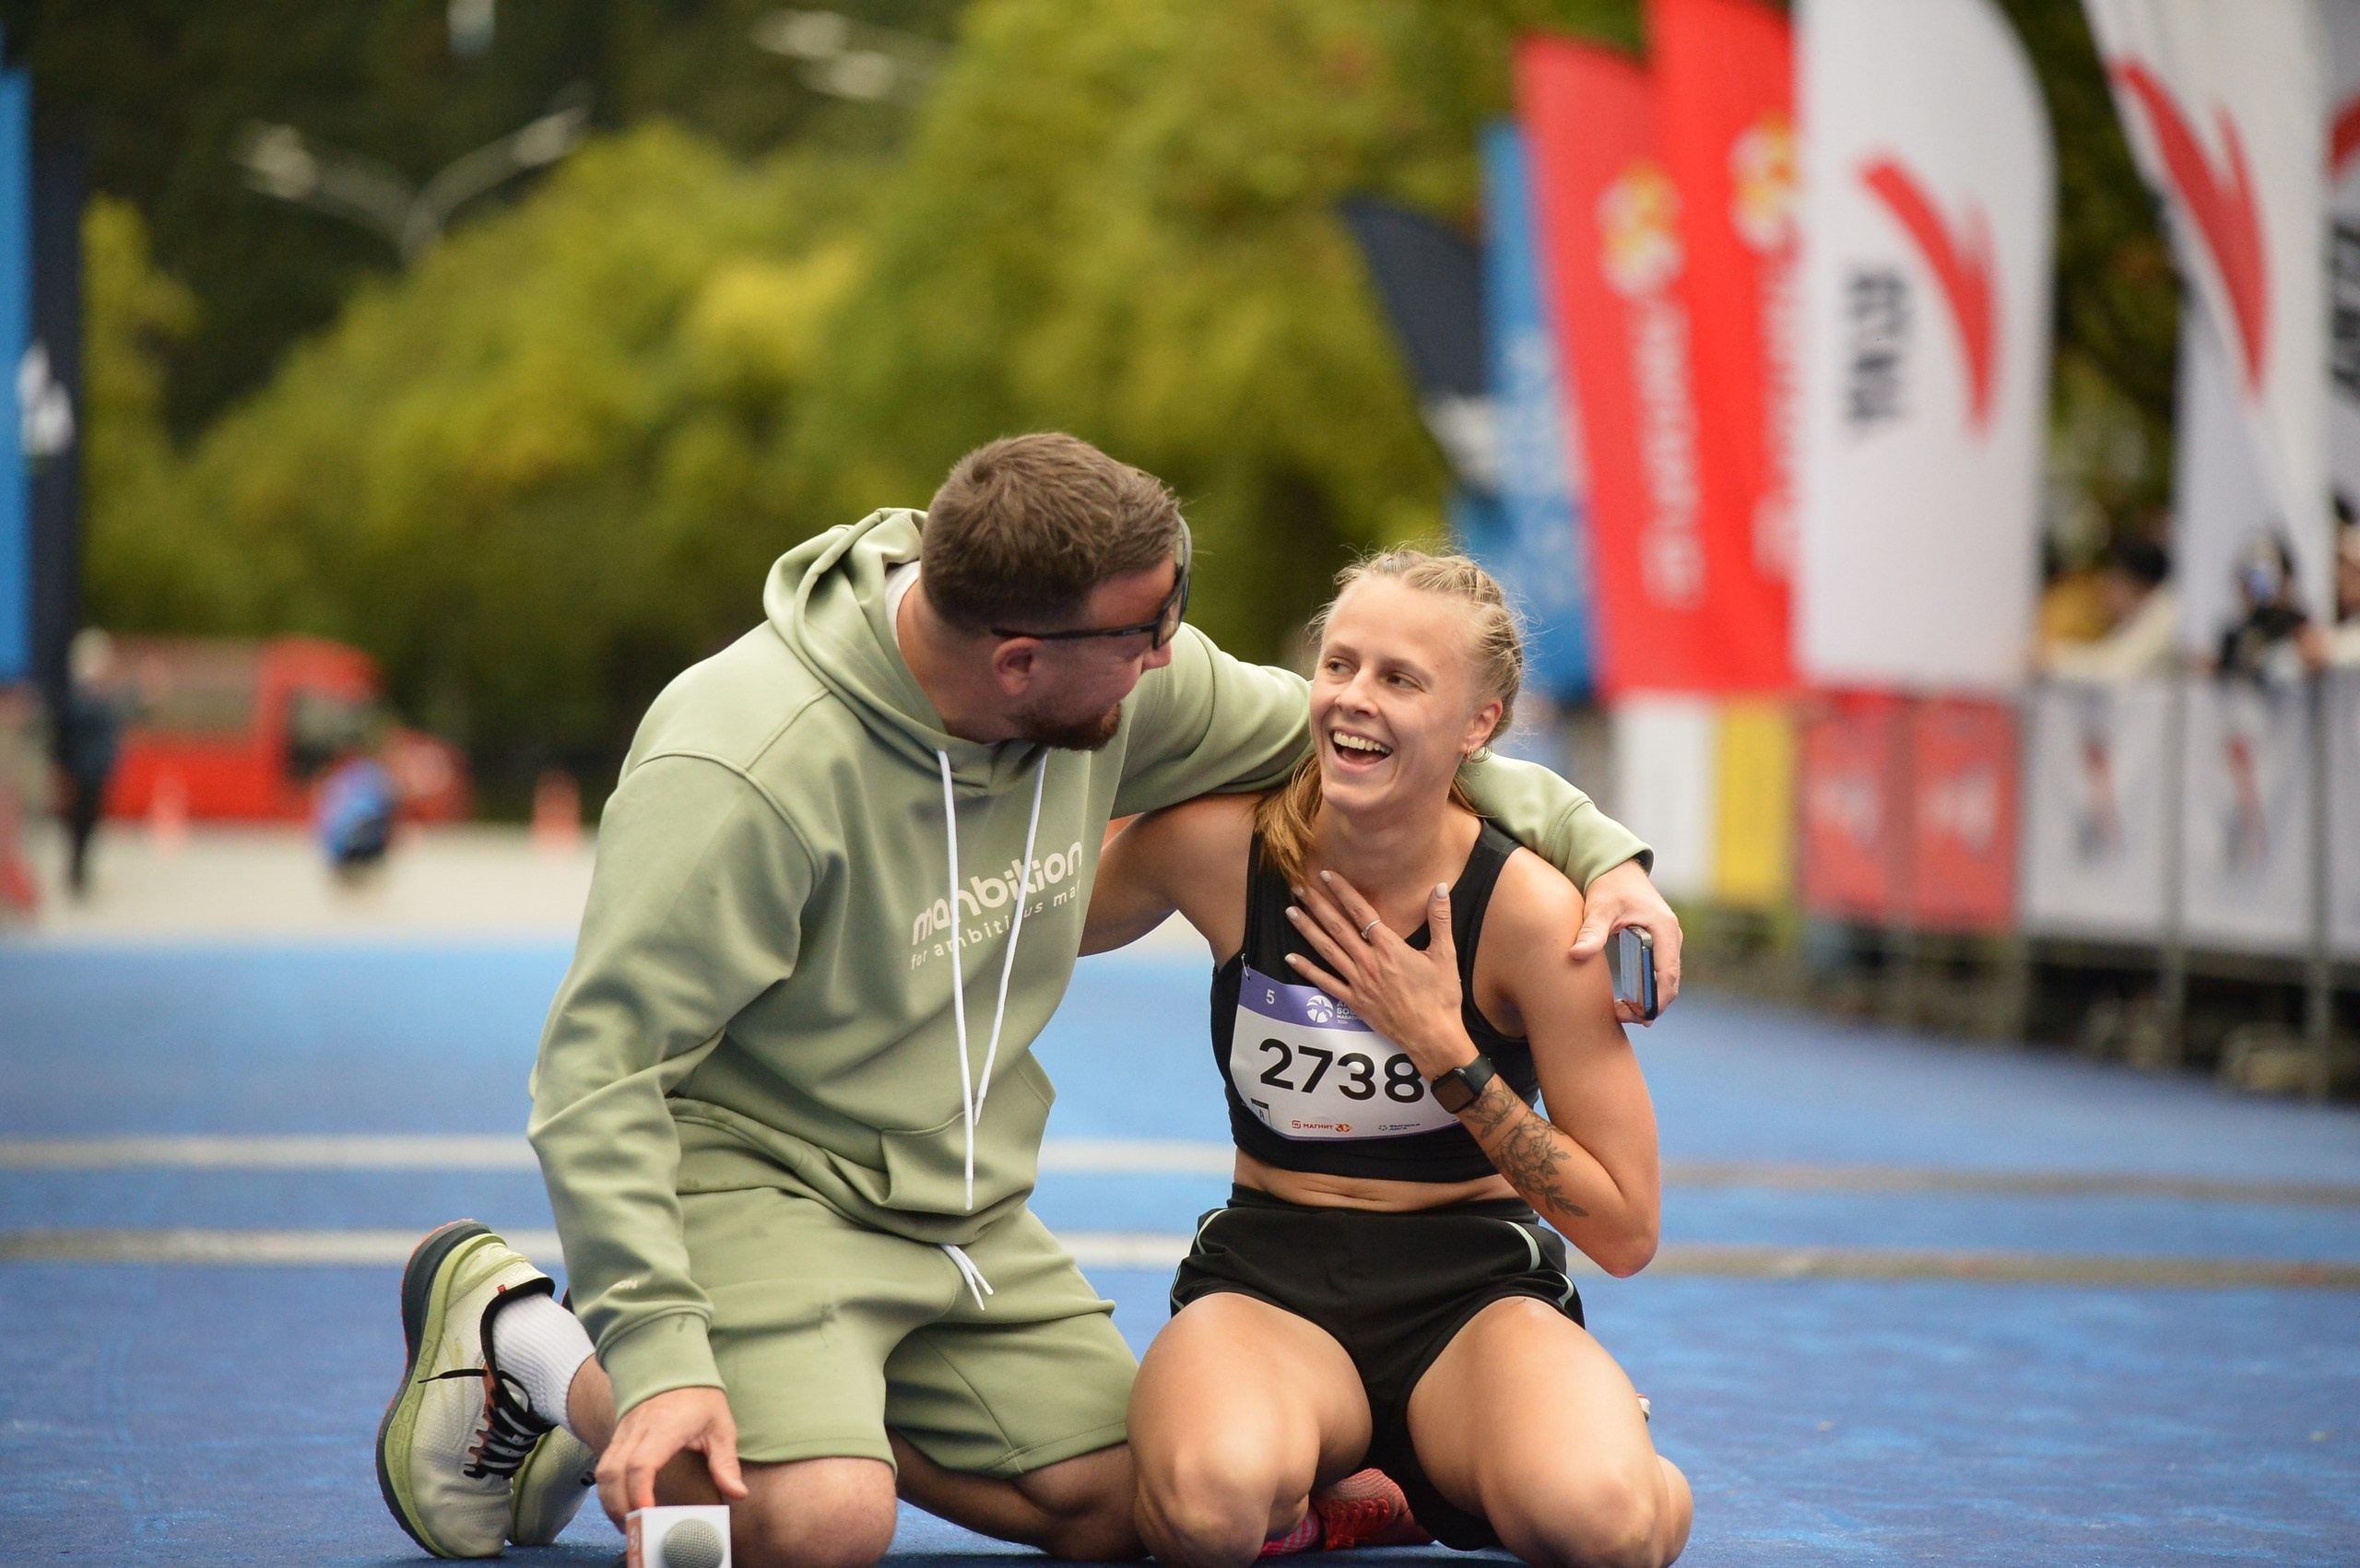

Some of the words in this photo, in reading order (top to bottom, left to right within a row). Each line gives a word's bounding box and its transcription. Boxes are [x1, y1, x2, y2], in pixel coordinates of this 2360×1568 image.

[912, 841, 1082, 946] manbition
[911, 949, 928, 970] for
[934, 902, 1044, 957] ambitius
[1266, 988, 1275, 1005] 5
[1258, 1038, 1424, 1103] 2738
